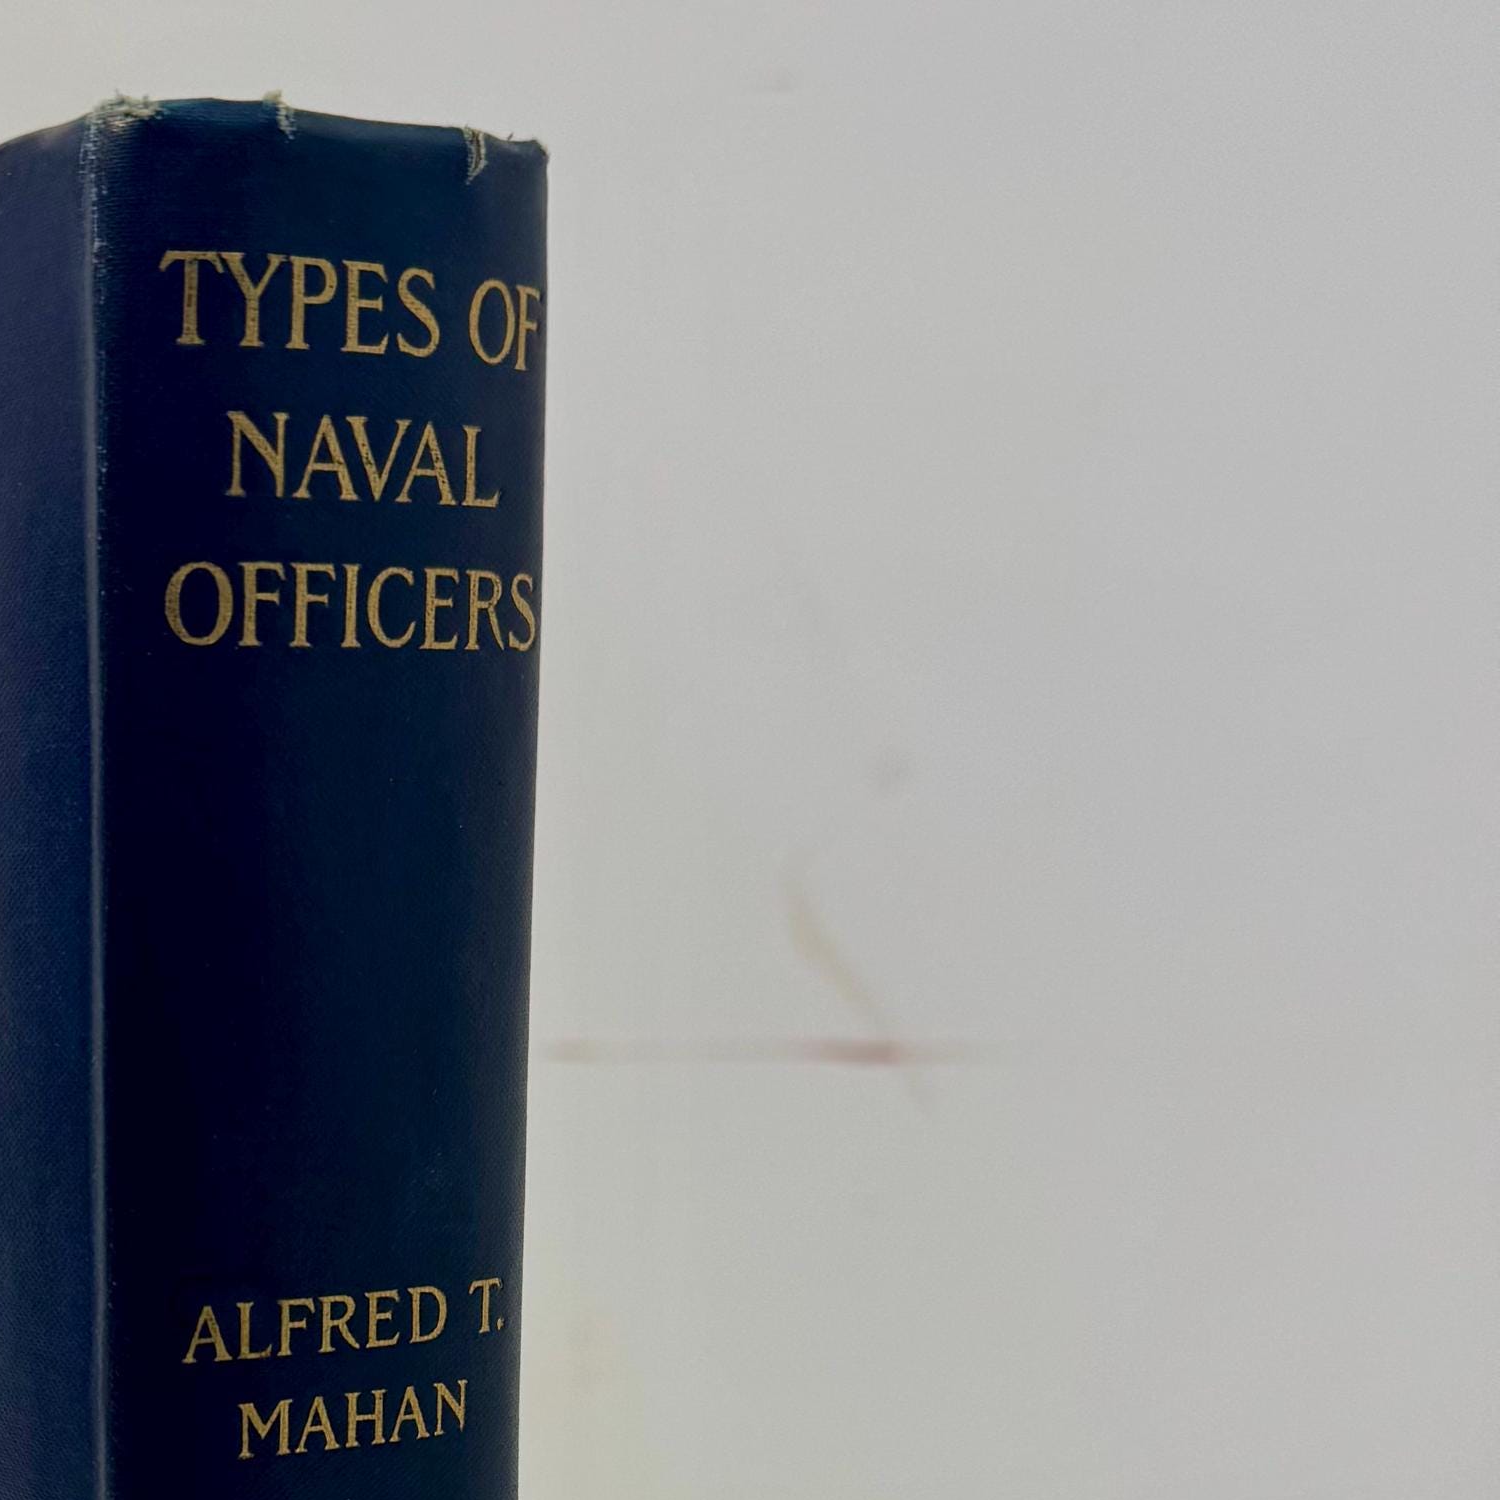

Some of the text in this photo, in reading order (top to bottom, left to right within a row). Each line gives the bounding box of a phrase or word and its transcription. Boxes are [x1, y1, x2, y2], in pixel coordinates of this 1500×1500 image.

[159, 250, 541, 371] TYPES OF
[226, 411, 501, 508] NAVAL
[164, 561, 536, 652] OFFICERS
[182, 1277, 505, 1364] ALFRED T.
[237, 1379, 468, 1459] MAHAN
